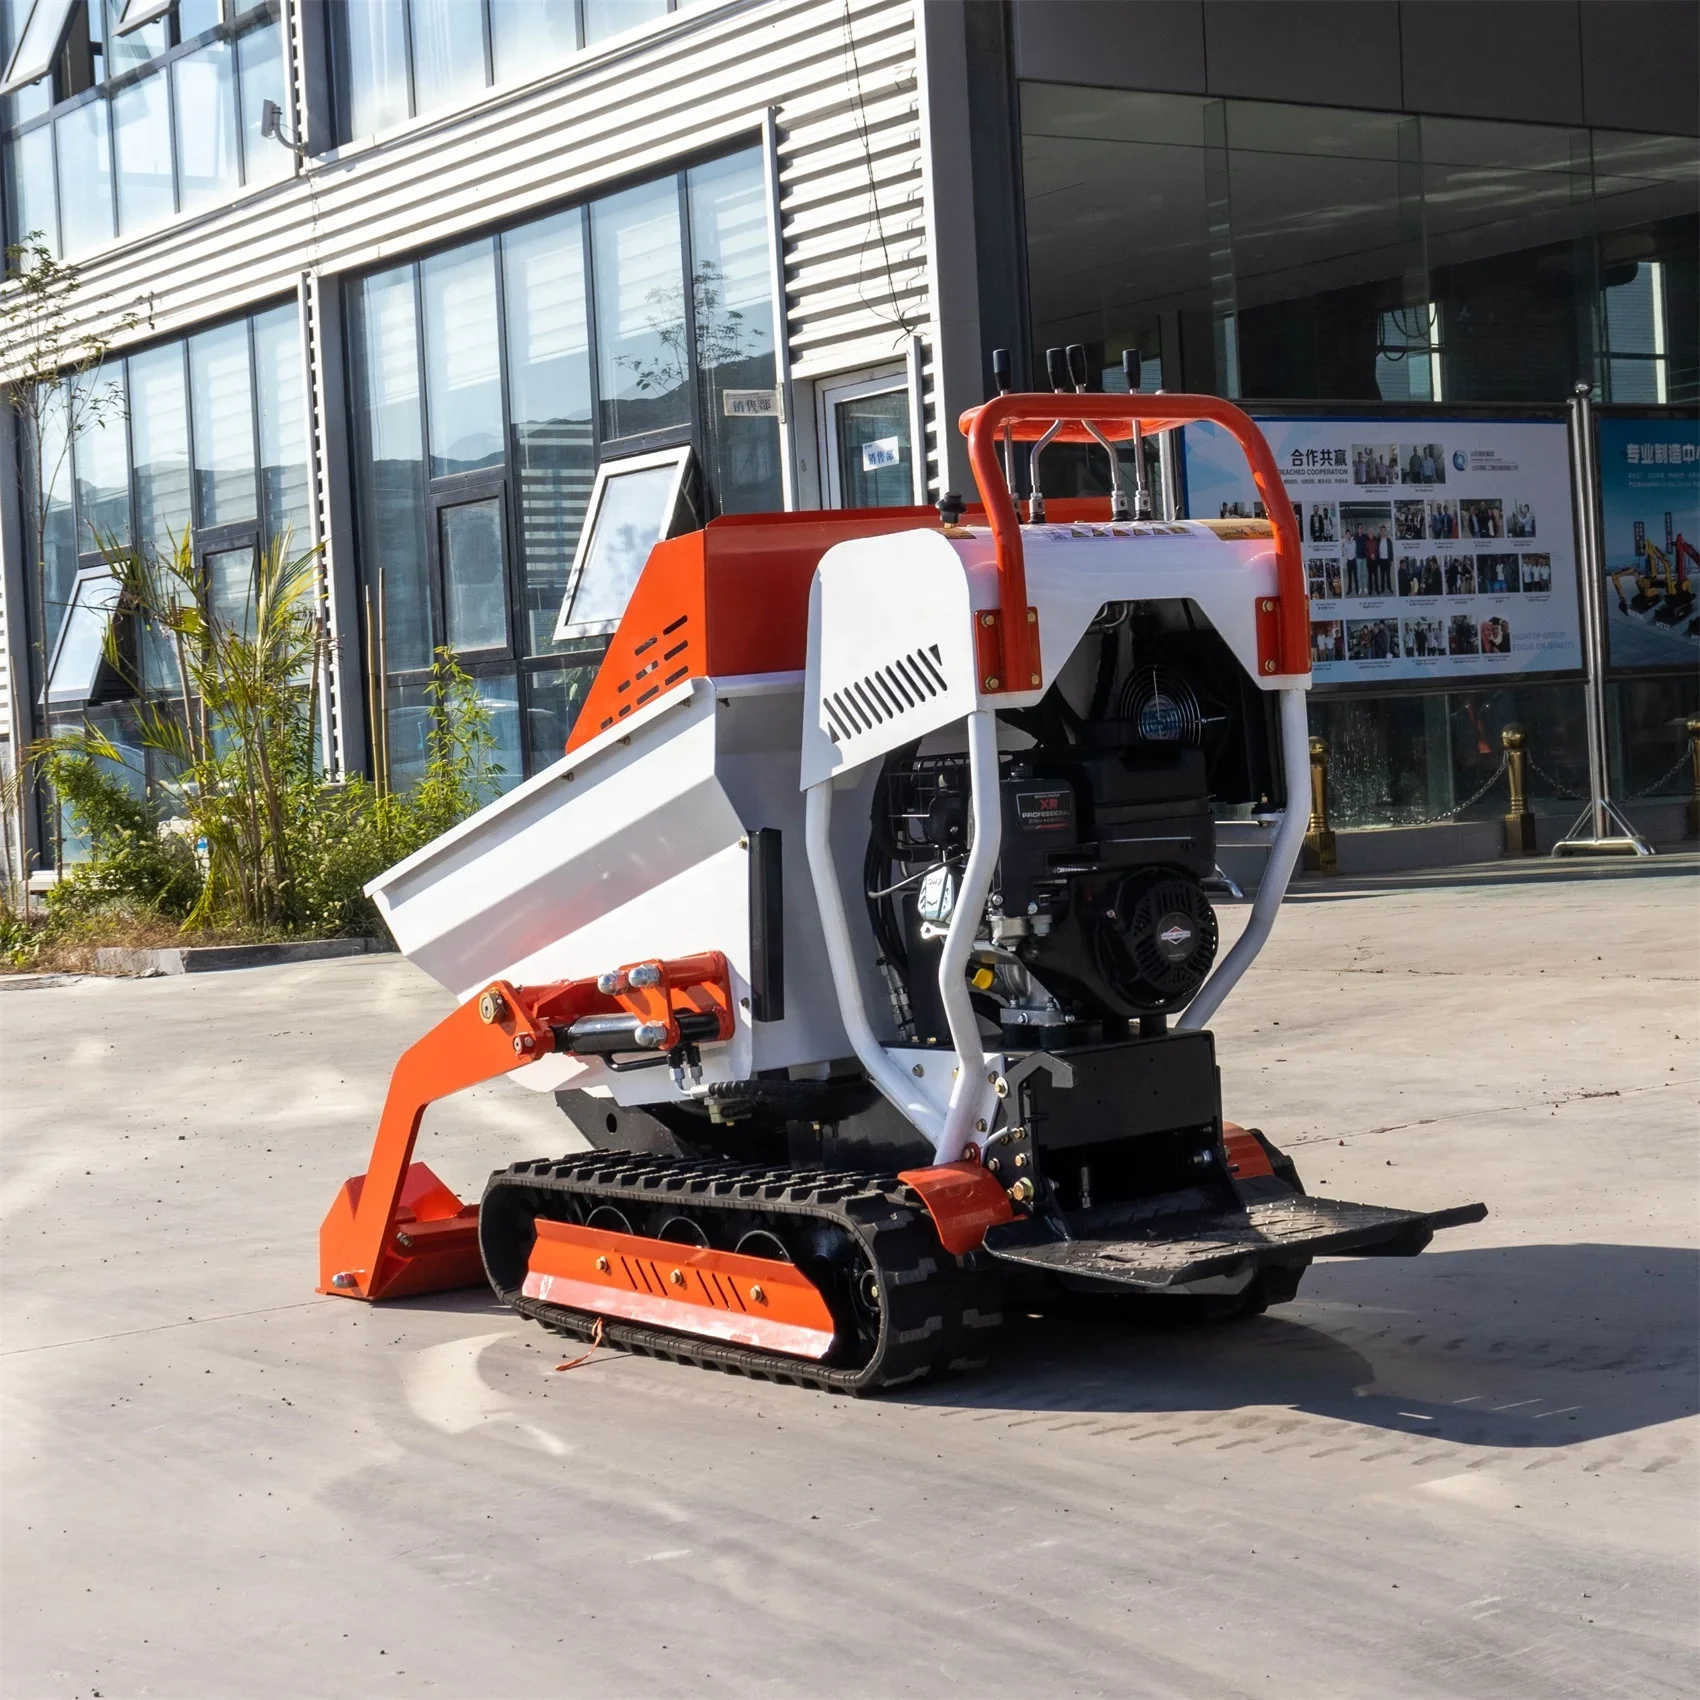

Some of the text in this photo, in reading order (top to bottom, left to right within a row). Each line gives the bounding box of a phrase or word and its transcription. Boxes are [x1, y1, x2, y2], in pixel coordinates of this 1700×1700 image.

[733, 399, 771, 413] 销售部
[868, 449, 894, 465] 销售部
[1290, 448, 1347, 467] 合作共赢
[1627, 443, 1700, 464] 专业制造中
[1306, 468, 1348, 476] COOPERATION
[1513, 643, 1534, 651] FOCUS
[1536, 642, 1546, 650] ON
[1040, 798, 1057, 810] XR
[1022, 810, 1070, 819] PROFESSIONAL
